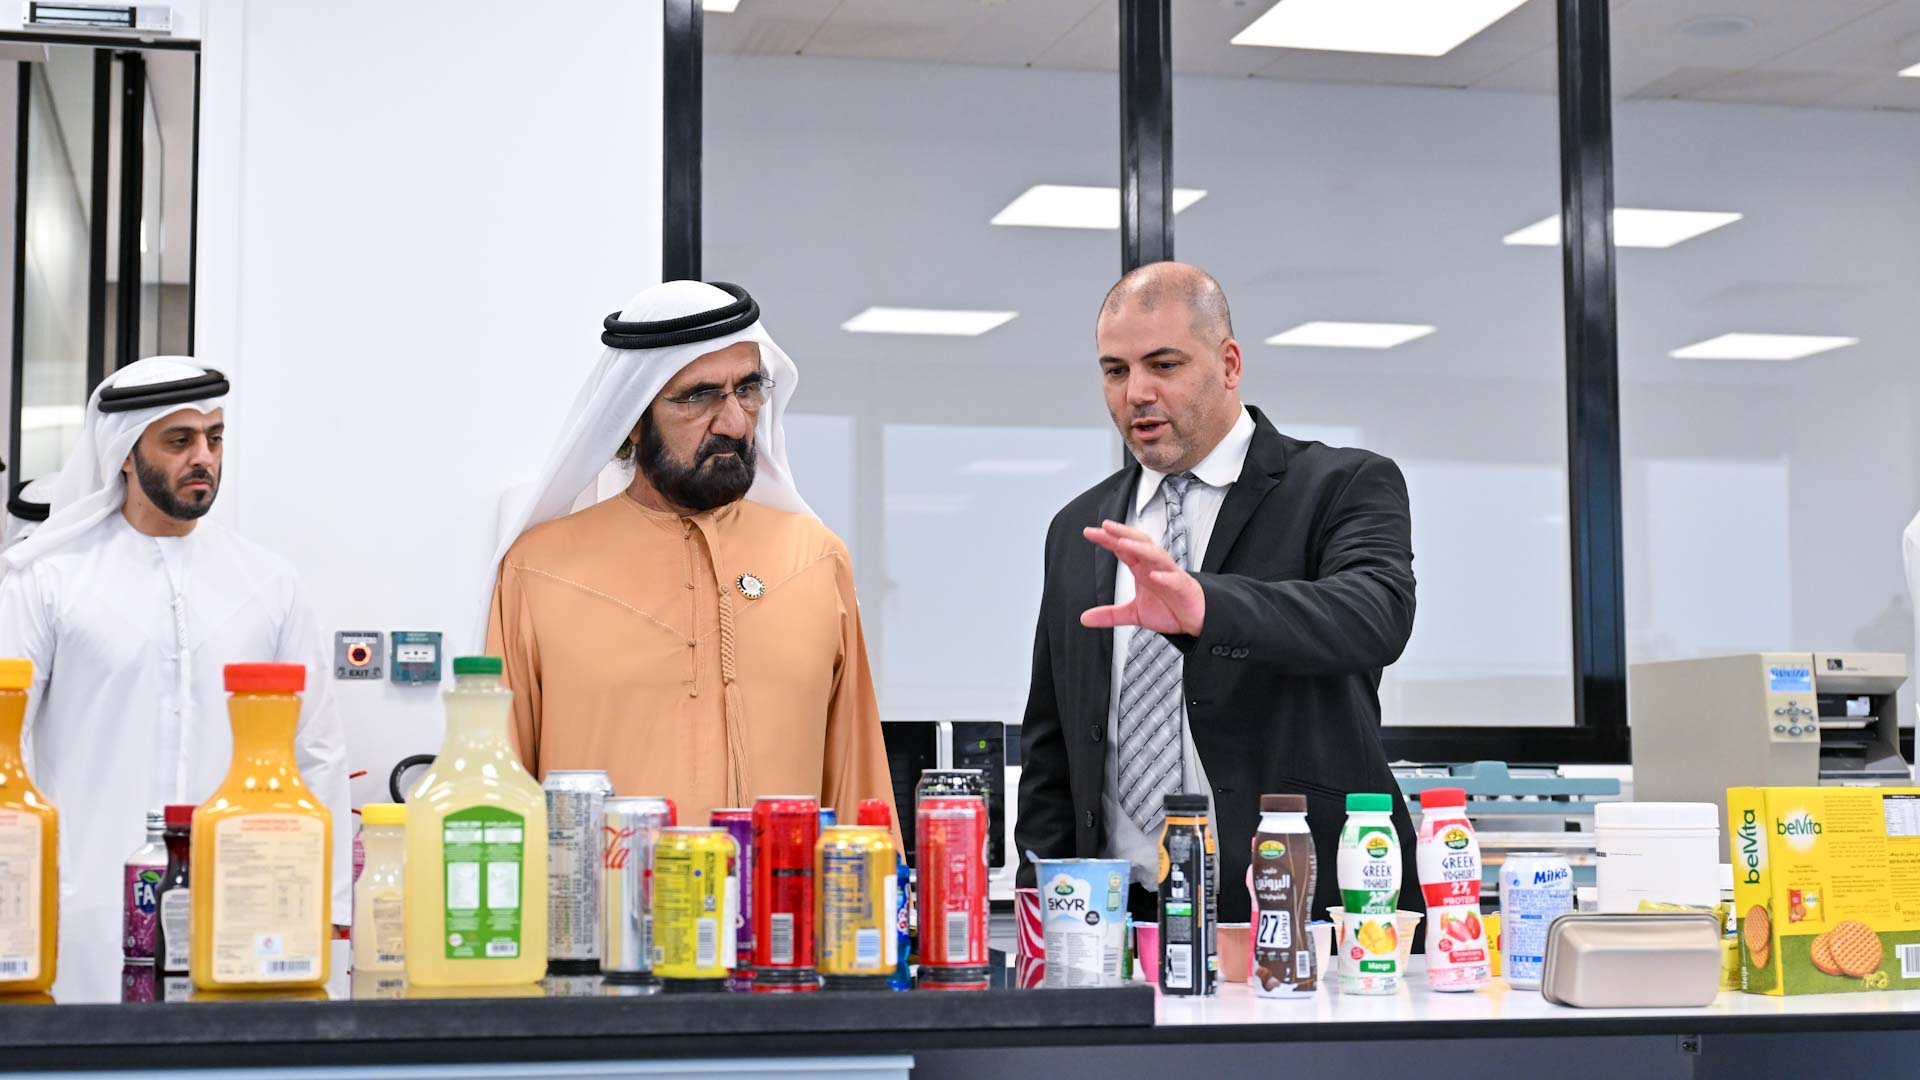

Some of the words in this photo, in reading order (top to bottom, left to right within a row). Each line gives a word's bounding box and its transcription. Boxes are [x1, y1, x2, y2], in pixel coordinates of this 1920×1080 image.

[1776, 813, 1822, 836] belVita
[1737, 809, 1760, 884] belVita
[1442, 856, 1475, 869] GREEK
[1362, 865, 1392, 877] GREEK
[1442, 869, 1476, 880] YOGHURT
[1533, 867, 1568, 885] Milkis
[1362, 878, 1392, 888] YOGHURT
[1048, 898, 1085, 911] SKYR
[1442, 895, 1476, 906] PROTEIN
[1259, 913, 1279, 944] 27
[1367, 962, 1391, 971] Mango
